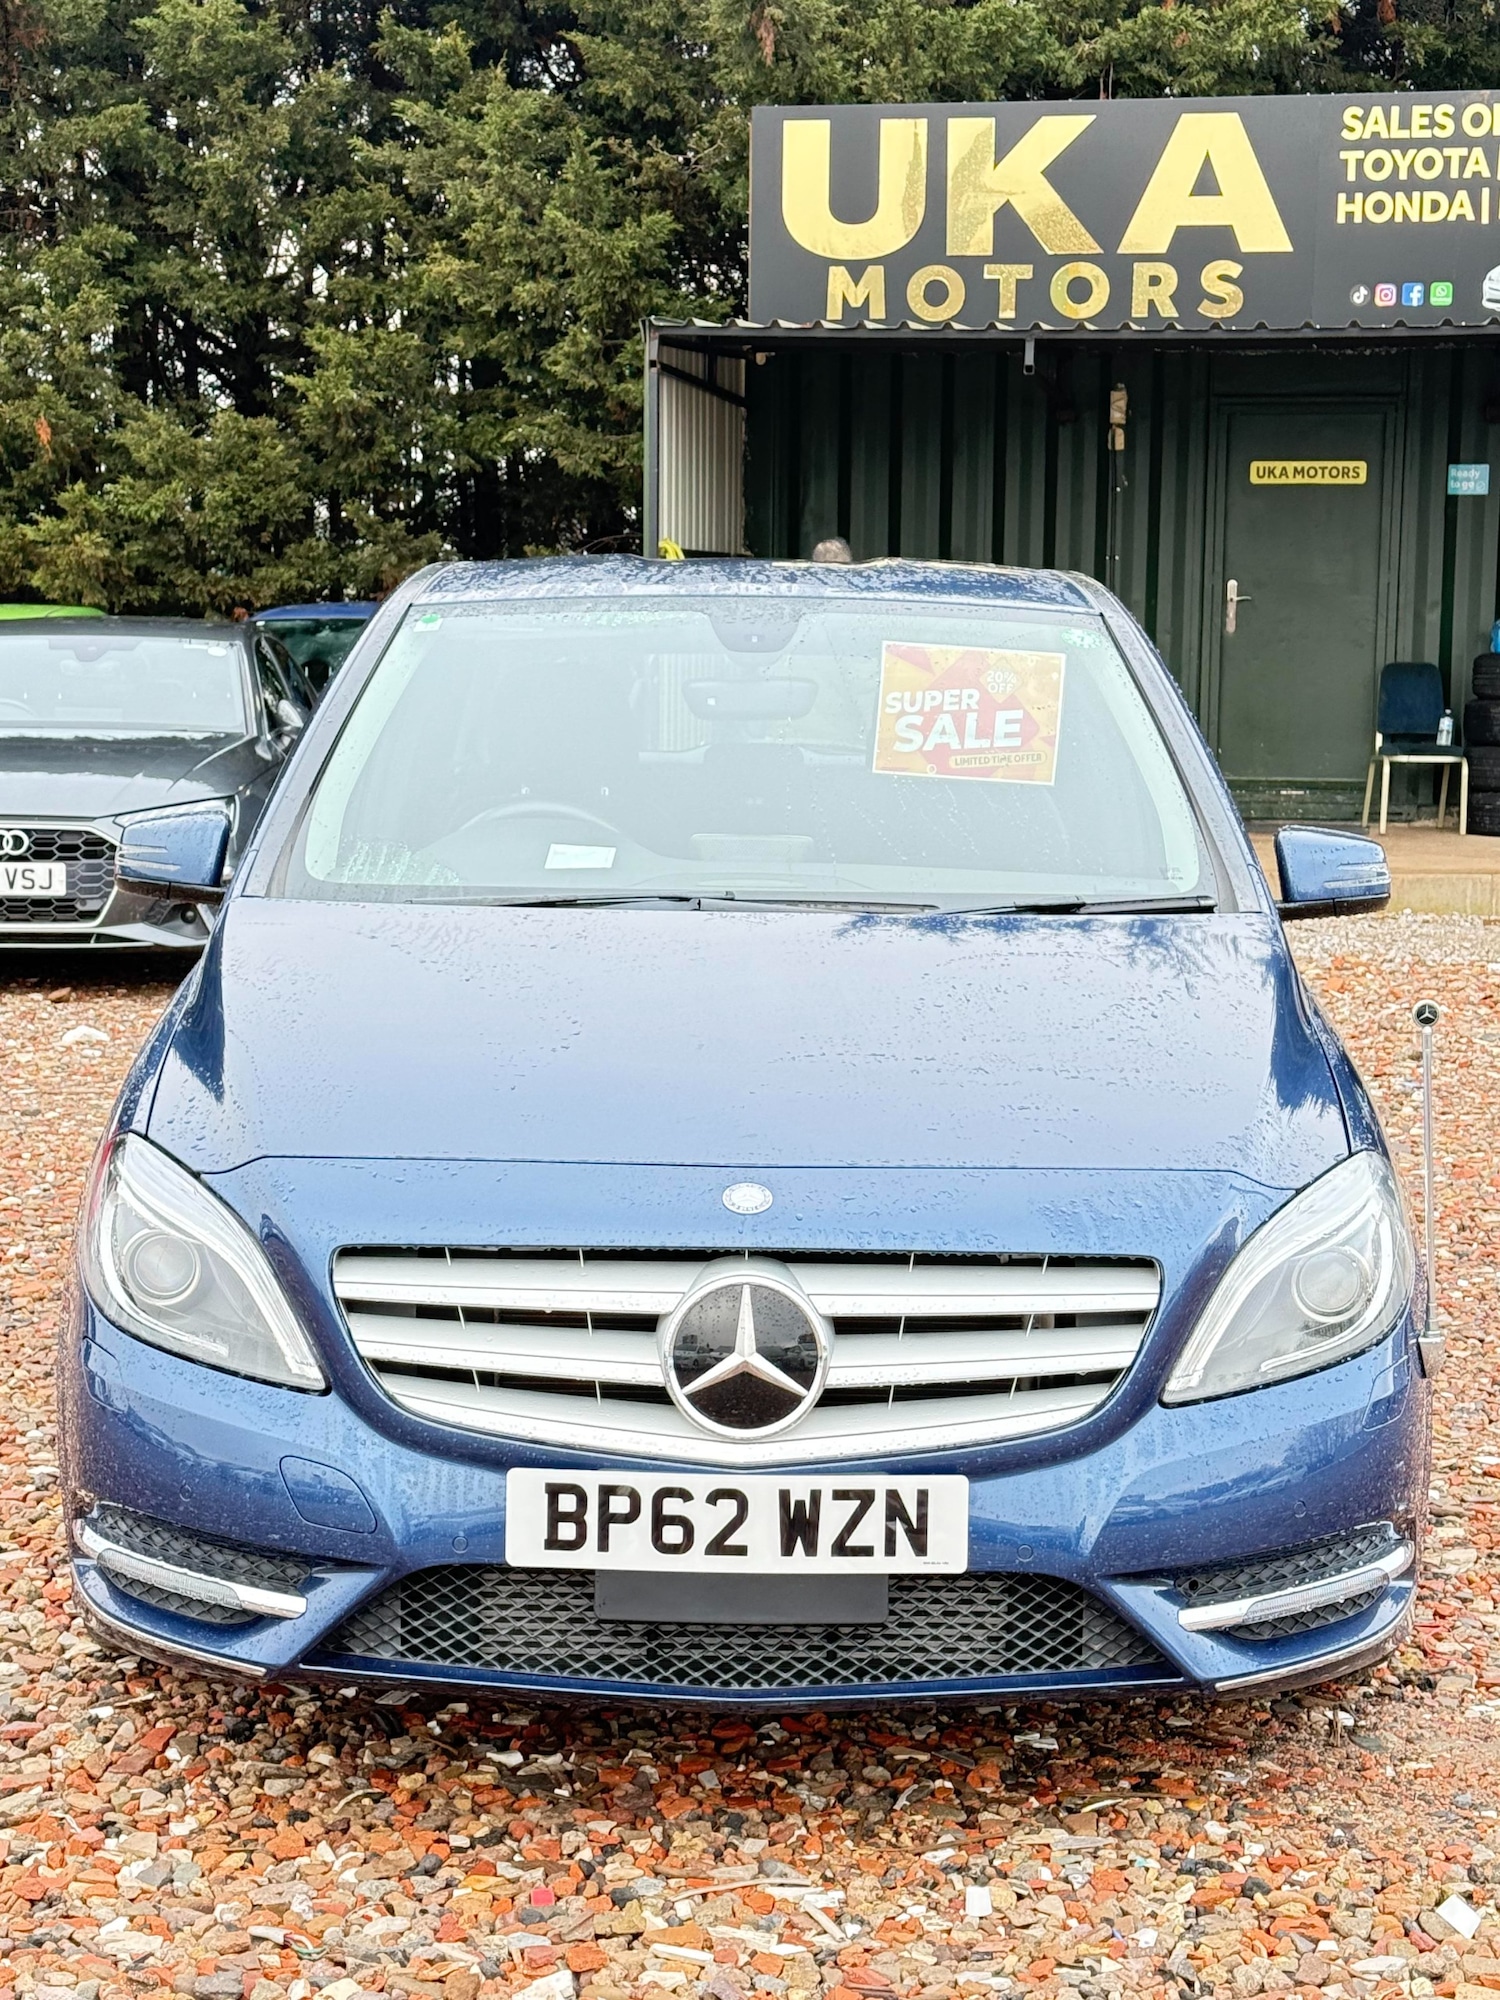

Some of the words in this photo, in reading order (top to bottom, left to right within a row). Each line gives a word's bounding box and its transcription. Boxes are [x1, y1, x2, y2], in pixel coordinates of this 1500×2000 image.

[1340, 103, 1456, 141] SALES
[1339, 146, 1491, 182] TOYOTA
[781, 111, 1294, 260] UKA
[1336, 189, 1476, 224] HONDA
[826, 259, 1245, 322] MOTORS
[1255, 465, 1289, 479] UKA
[1292, 465, 1361, 479] MOTORS
[1450, 468, 1480, 480] Ready
[1461, 481, 1475, 491] go
[986, 670, 1017, 683] 20%
[987, 682, 1014, 693] OFF
[884, 688, 980, 714] SUPER
[892, 709, 1024, 753] SALE
[954, 756, 990, 766] LIMITED
[1014, 753, 1042, 763] OFFER
[4, 867, 52, 890] VSJ
[543, 1482, 749, 1557] BP62
[778, 1488, 930, 1557] WZN
